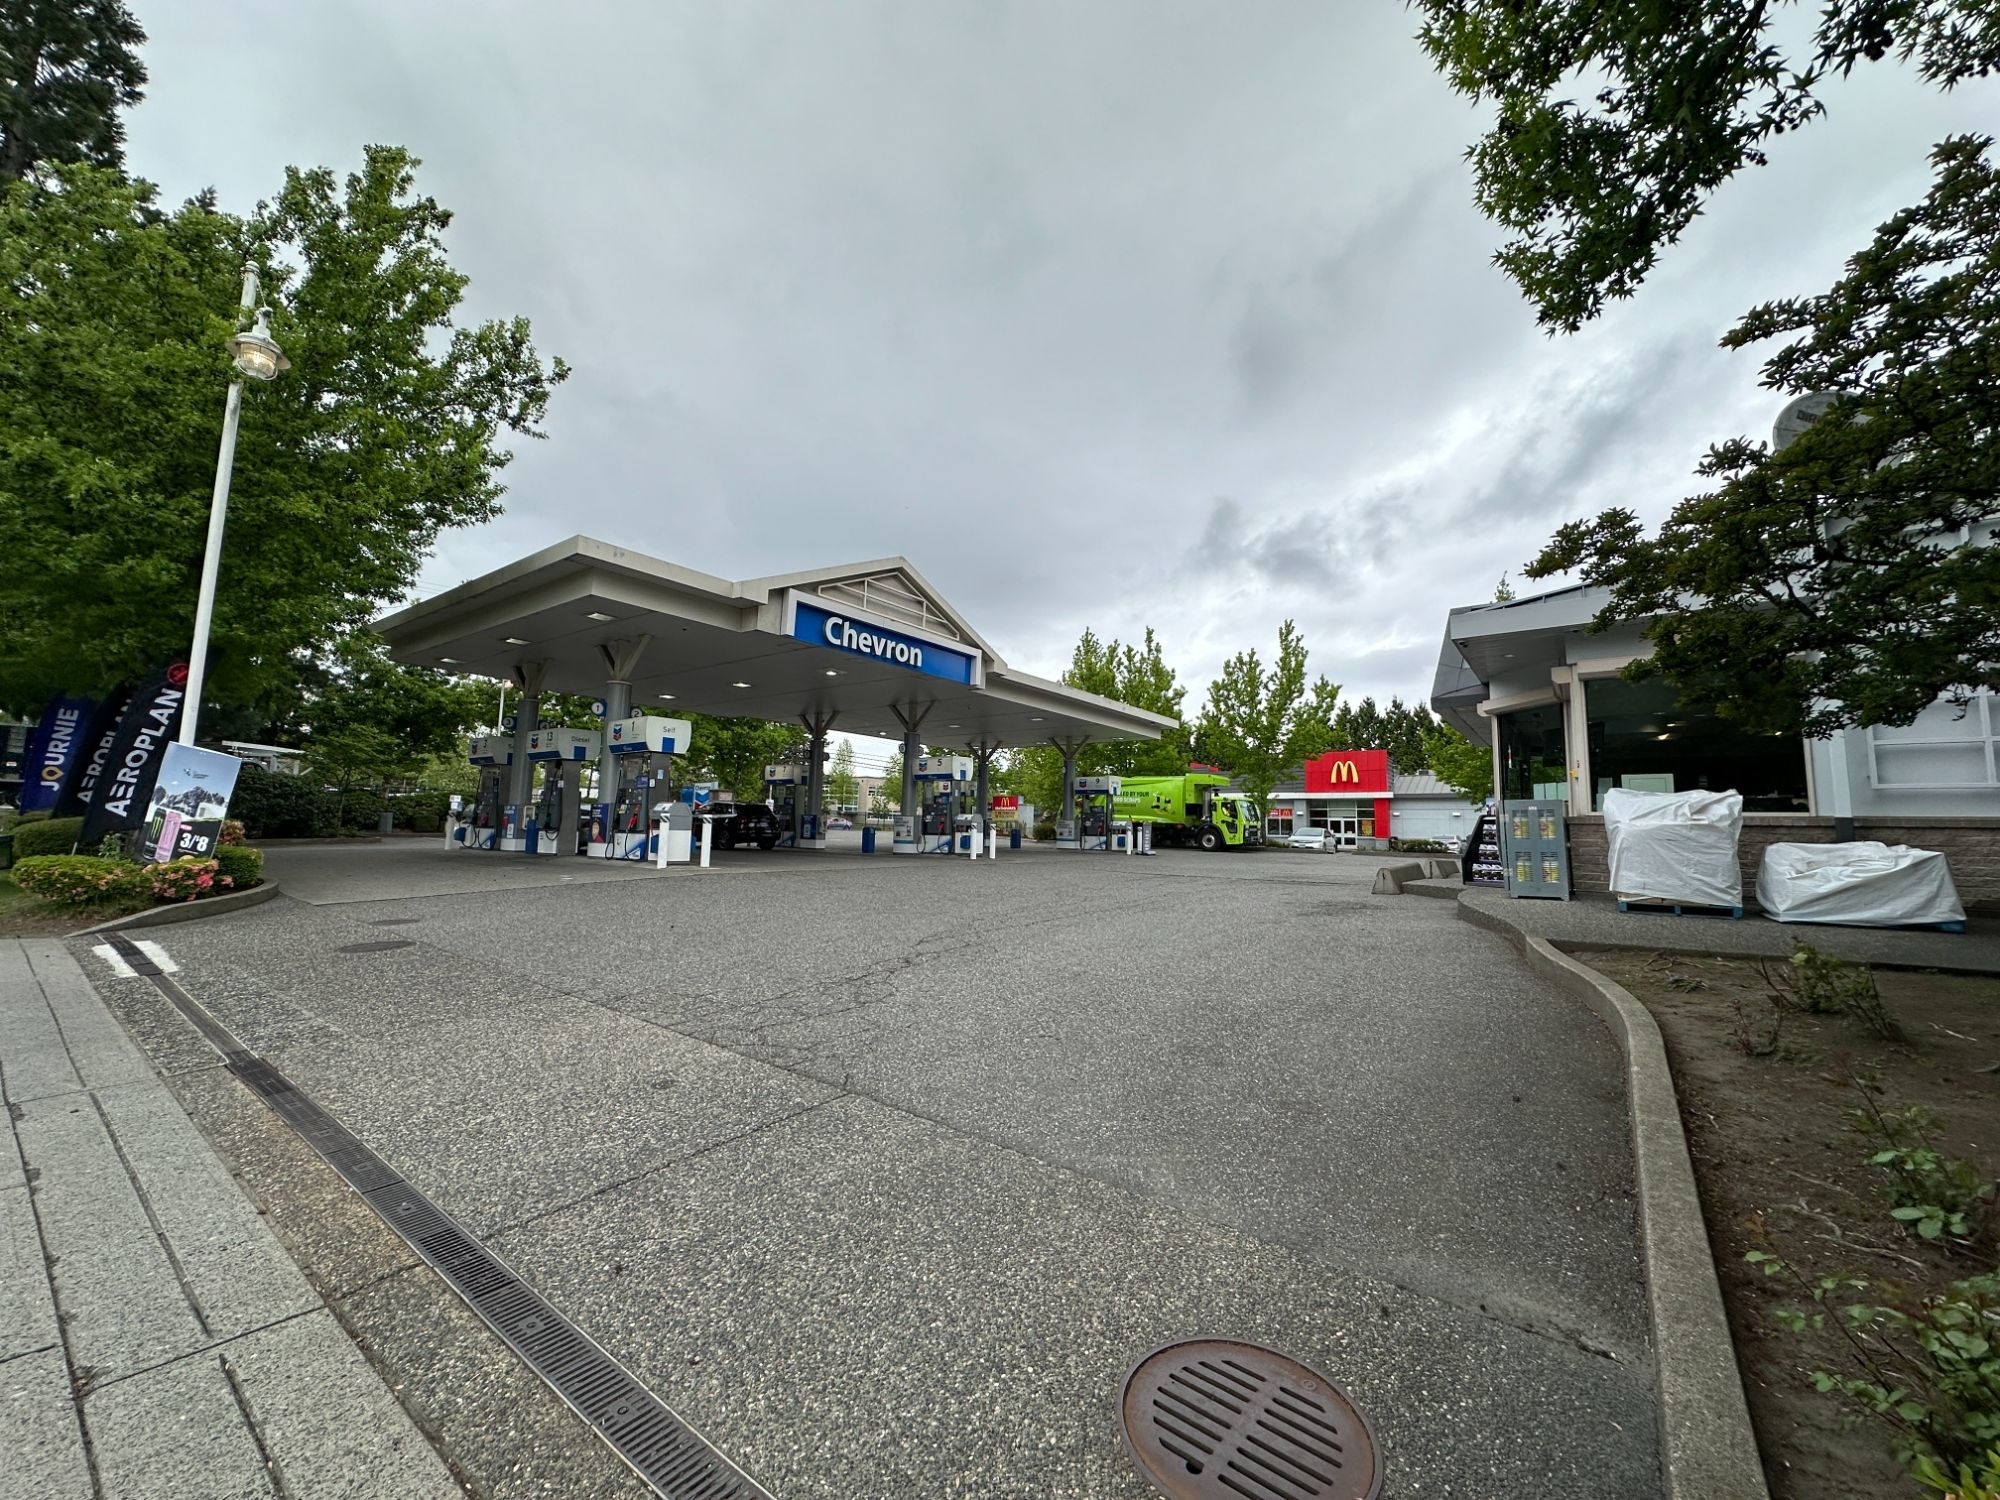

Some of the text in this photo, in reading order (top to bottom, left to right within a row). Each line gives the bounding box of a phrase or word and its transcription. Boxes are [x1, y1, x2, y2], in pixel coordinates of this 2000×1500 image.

[825, 616, 923, 667] Chevron
[662, 726, 676, 734] Self
[546, 731, 554, 742] 13
[571, 735, 590, 743] Diesel
[40, 707, 80, 792] JOURNIE
[105, 687, 183, 817] AEROPLAN
[937, 758, 943, 767] 5
[1095, 778, 1100, 786] 9
